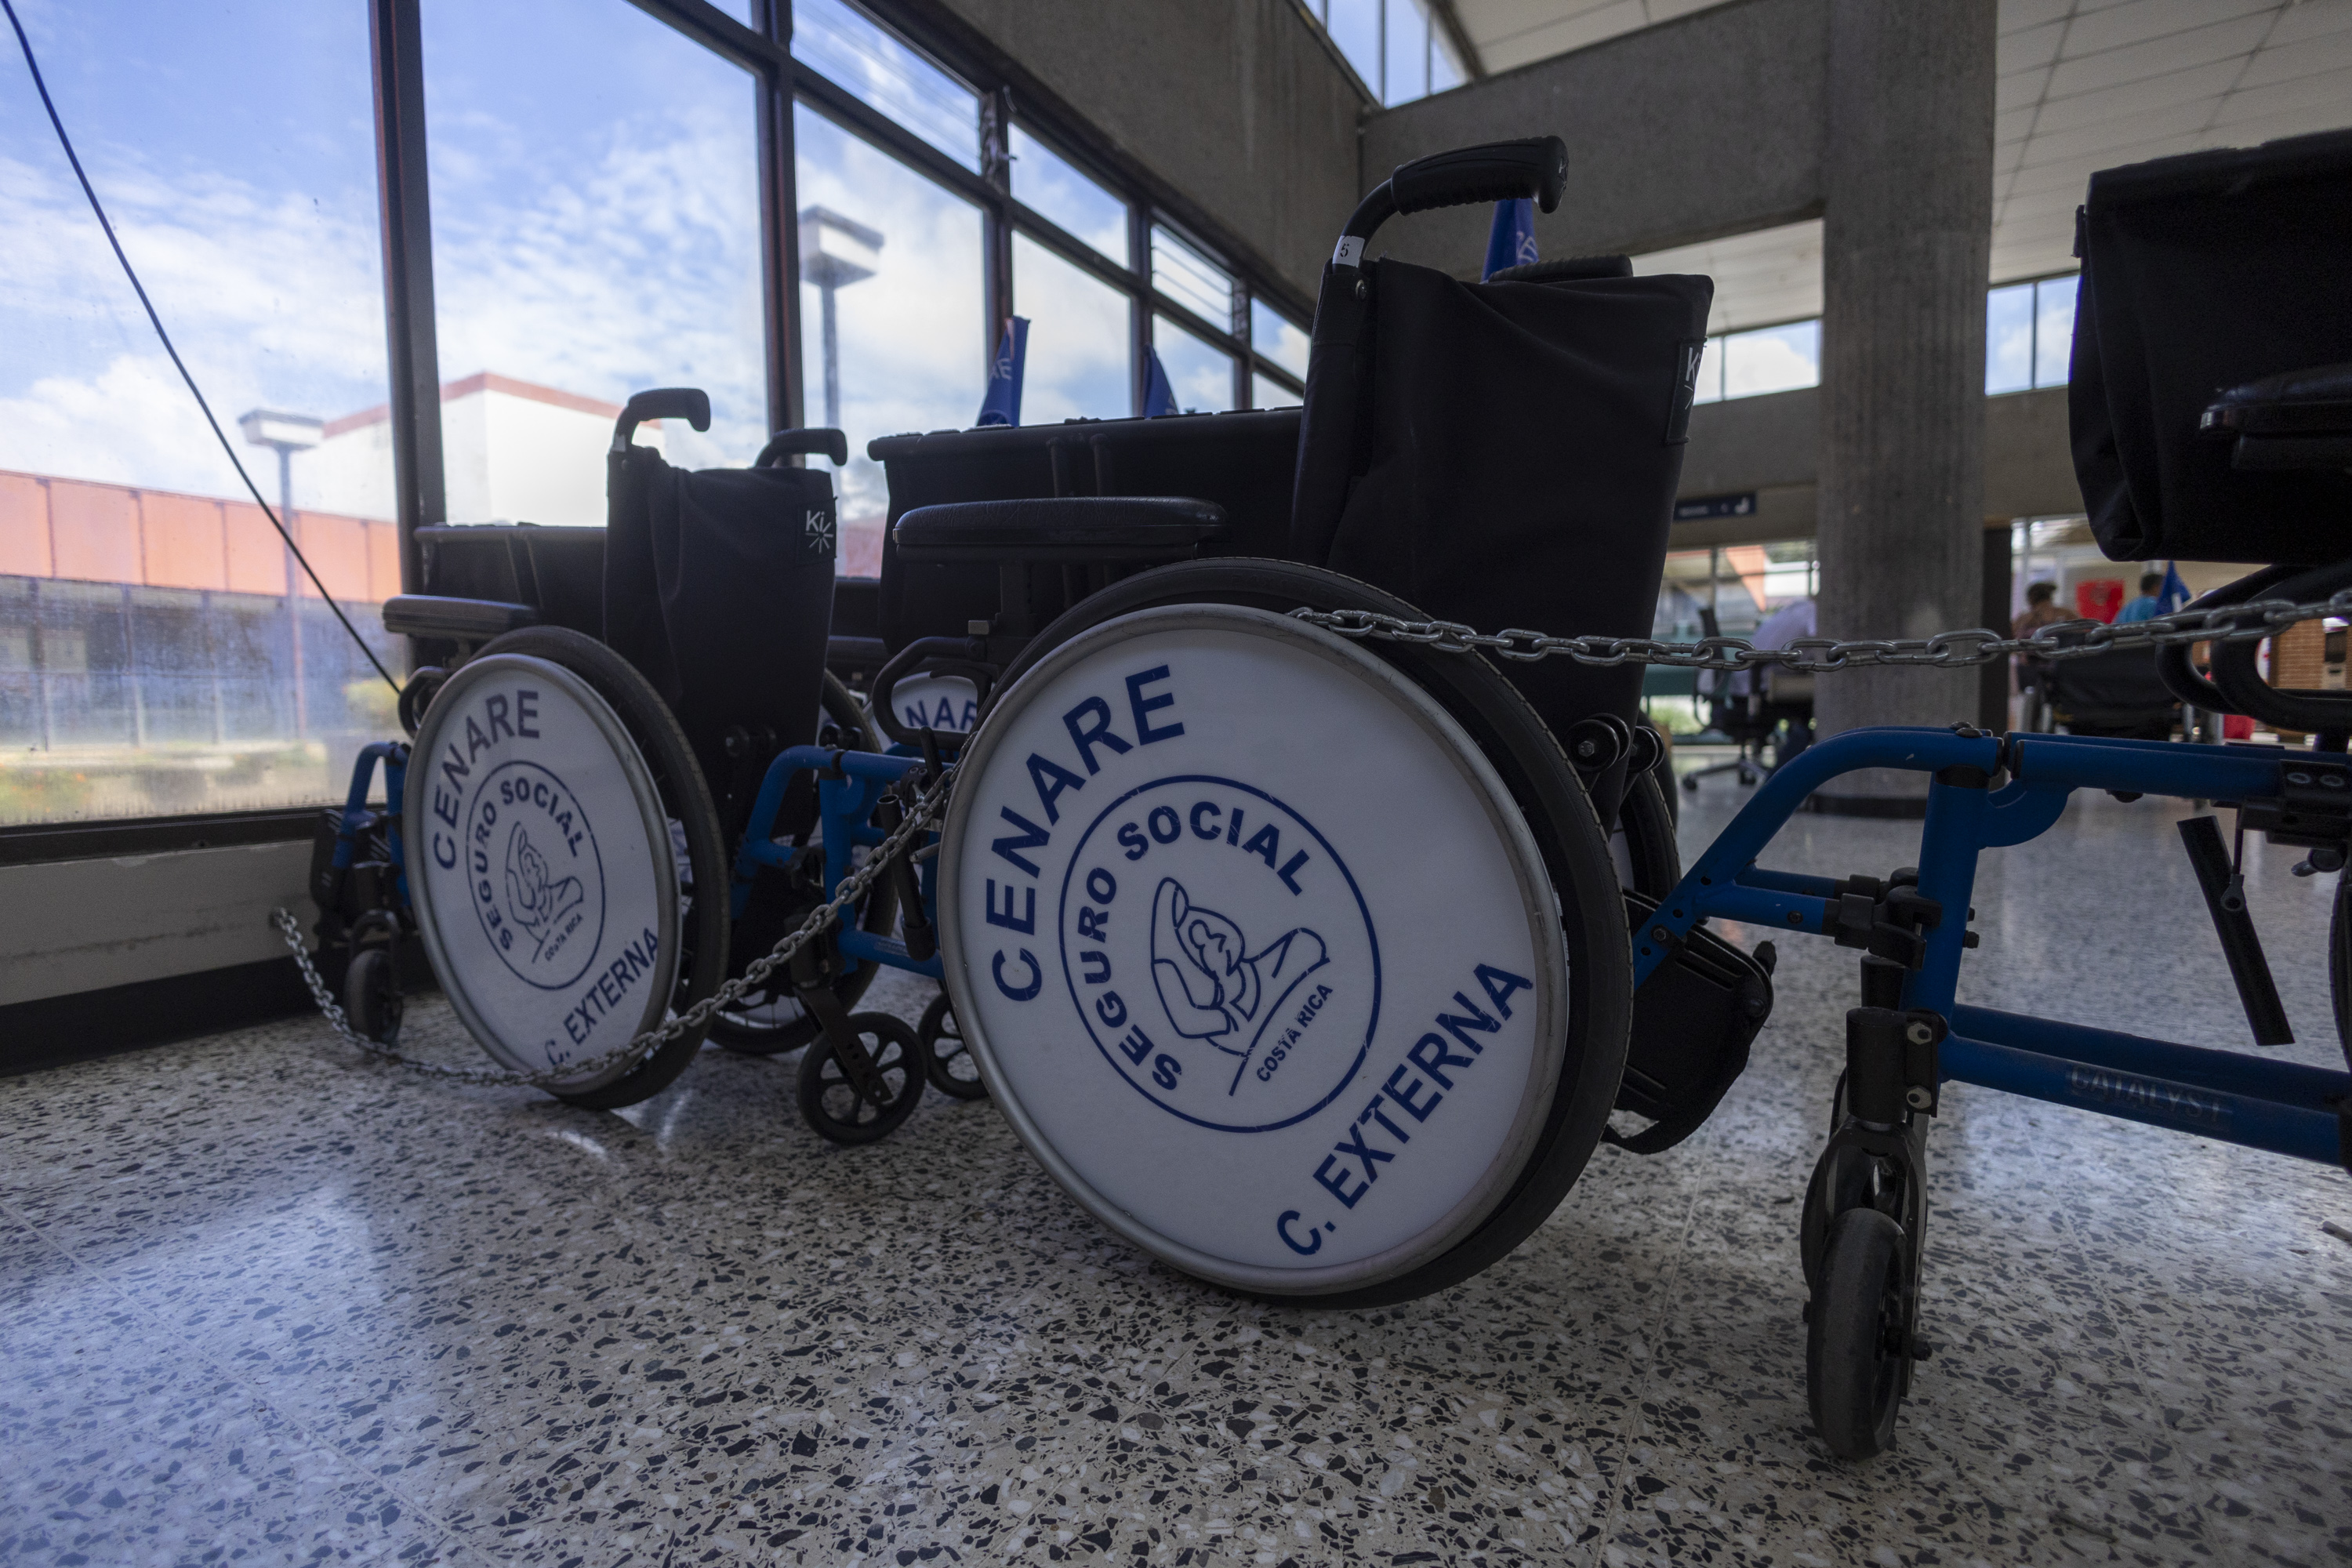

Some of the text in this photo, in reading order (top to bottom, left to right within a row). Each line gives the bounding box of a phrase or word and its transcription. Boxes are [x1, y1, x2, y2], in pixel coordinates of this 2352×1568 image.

[1340, 243, 1350, 258] 5
[806, 510, 825, 532] Ki
[434, 689, 540, 870] CENARE
[985, 664, 1185, 1003] CENARE
[474, 777, 583, 950] SEGURO SOCIAL
[564, 913, 584, 936] RICA
[1077, 800, 1311, 1091] SEGURO SOCIAL
[563, 927, 658, 1046] EXTERNA
[1256, 984, 1333, 1082] COSTA RICA
[1276, 963, 1534, 1256] C. EXTERNA
[2070, 1064, 2223, 1123] CATALYST
